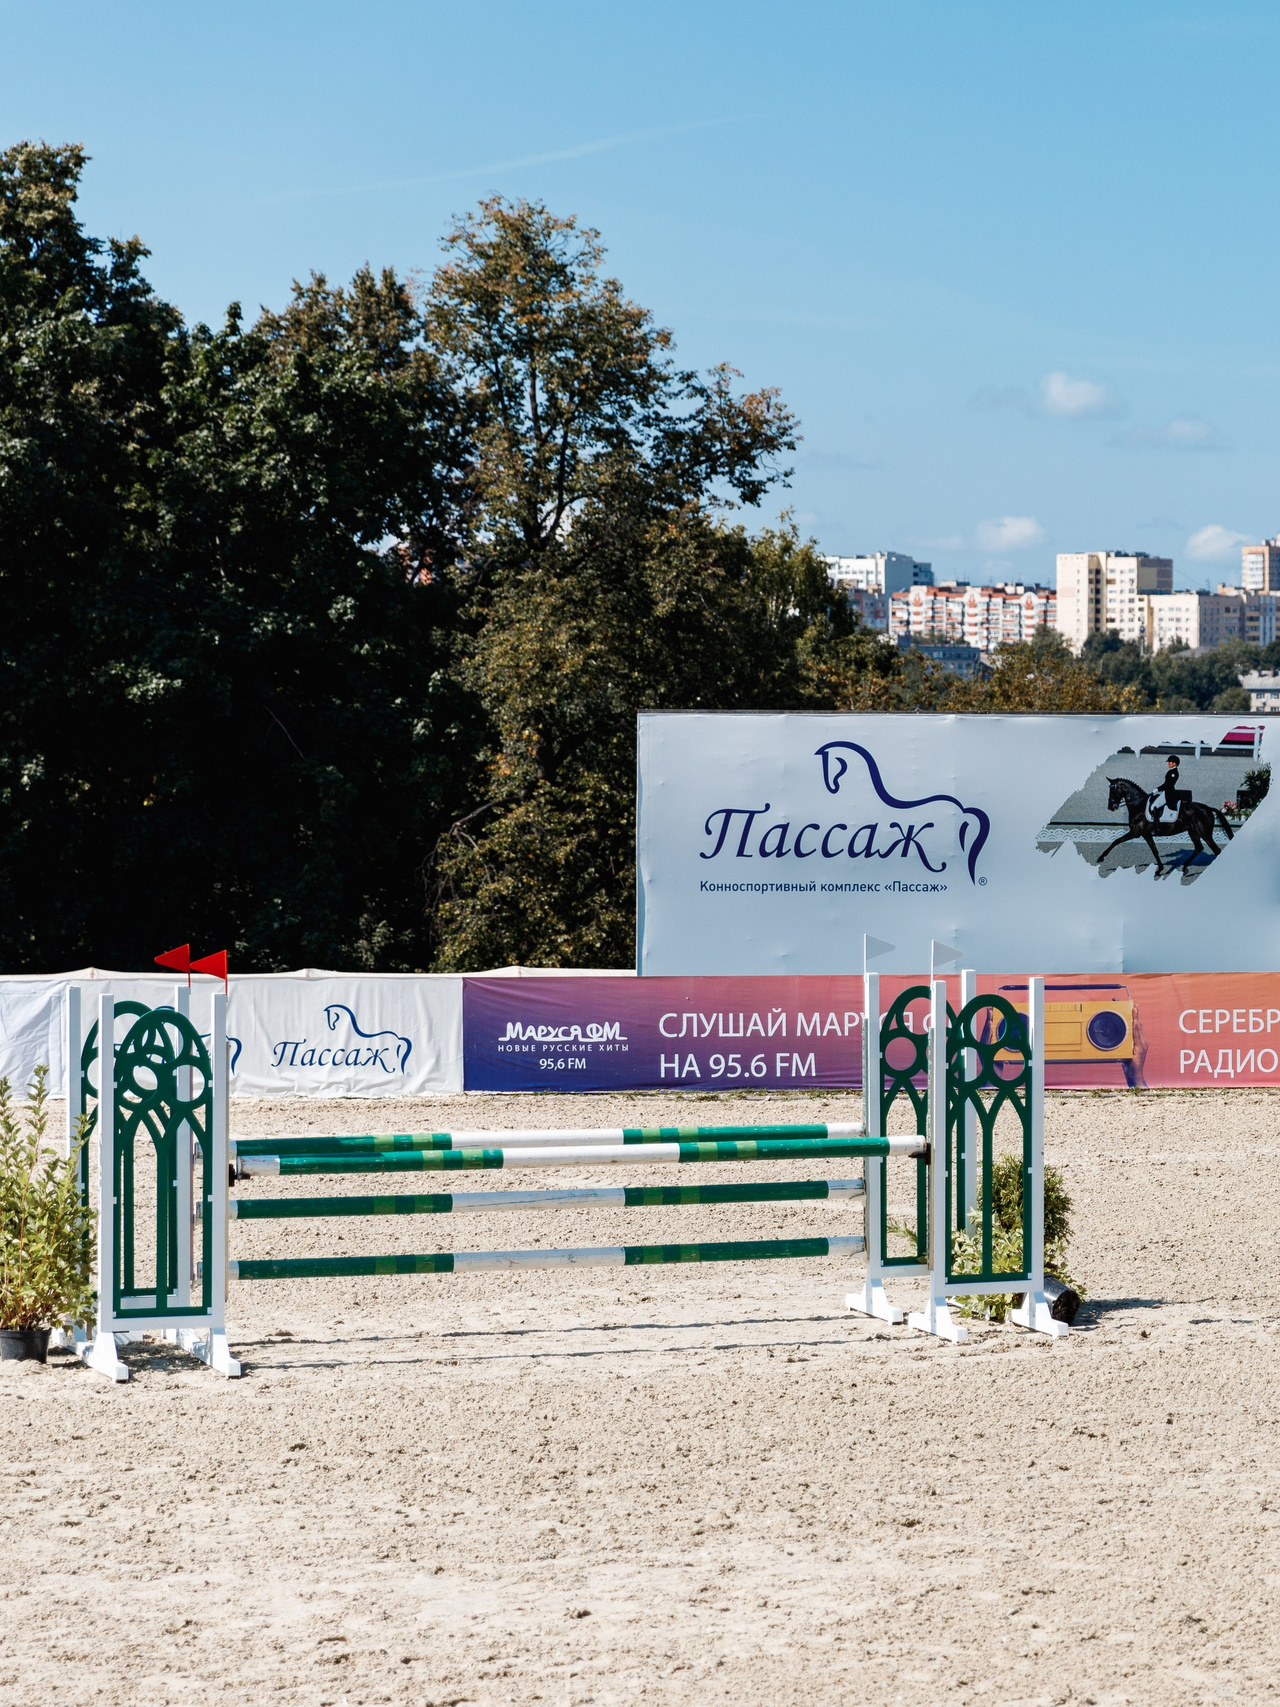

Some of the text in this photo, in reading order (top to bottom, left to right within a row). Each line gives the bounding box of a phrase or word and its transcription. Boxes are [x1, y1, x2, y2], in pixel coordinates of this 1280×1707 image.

[700, 803, 947, 873] Пассаж
[700, 880, 948, 894] Конноспортивный комплекс «Пассаж»
[585, 1021, 628, 1043] ФМ
[658, 1007, 787, 1038] СЛУШАЙ
[271, 1041, 396, 1074] Пассаж
[498, 1044, 536, 1052] НОВЫЕ
[542, 1044, 593, 1052] РУССКИЕ
[539, 1057, 587, 1070] 95,6 FM
[660, 1052, 817, 1078] НА 95.6 FM
[1179, 1048, 1279, 1078] РАДИО
